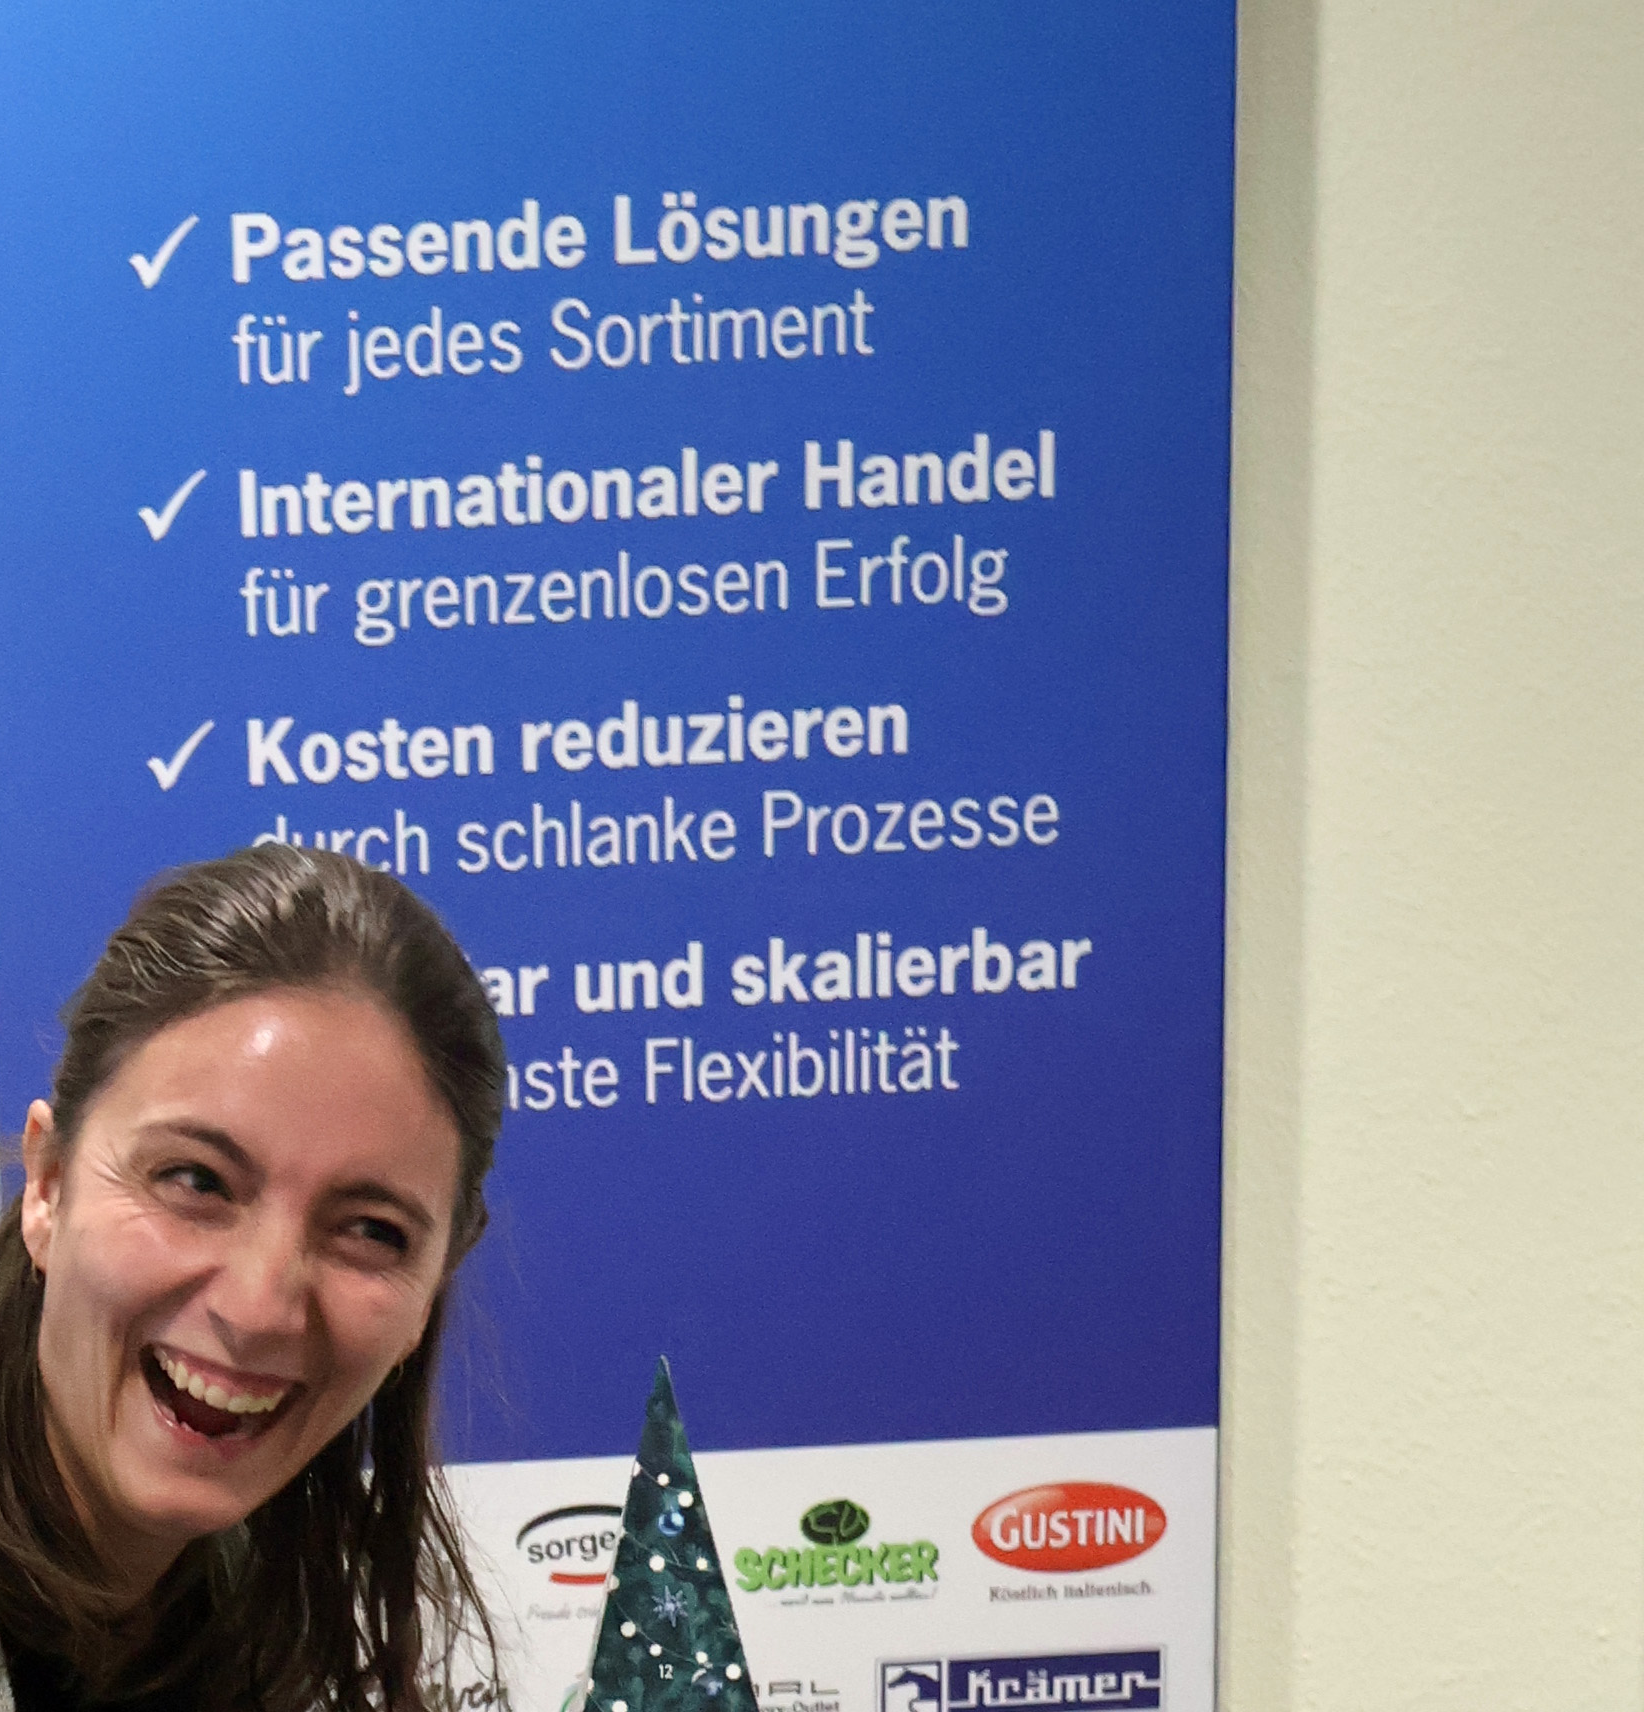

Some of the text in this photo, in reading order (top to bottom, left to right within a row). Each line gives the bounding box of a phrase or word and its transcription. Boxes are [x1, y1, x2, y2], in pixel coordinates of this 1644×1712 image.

[229, 192, 969, 285] Passende Lösungen
[232, 289, 874, 396] für jedes Sortiment
[239, 430, 1056, 538] Internationaler Handel
[241, 534, 1010, 647] für grenzenlosen Erfolg
[245, 695, 910, 788] Kosten reduzieren
[456, 797, 738, 874] schlanke
[762, 790, 1061, 857] Prozesse
[574, 942, 703, 1013] und
[730, 927, 1092, 1005] skalierbar
[644, 1028, 960, 1106] Flexibilität
[734, 1539, 940, 1592] SCHECKER
[990, 1506, 1145, 1551] GUSTINI
[658, 1663, 674, 1681] 12
[964, 1667, 1152, 1706] Krämer
